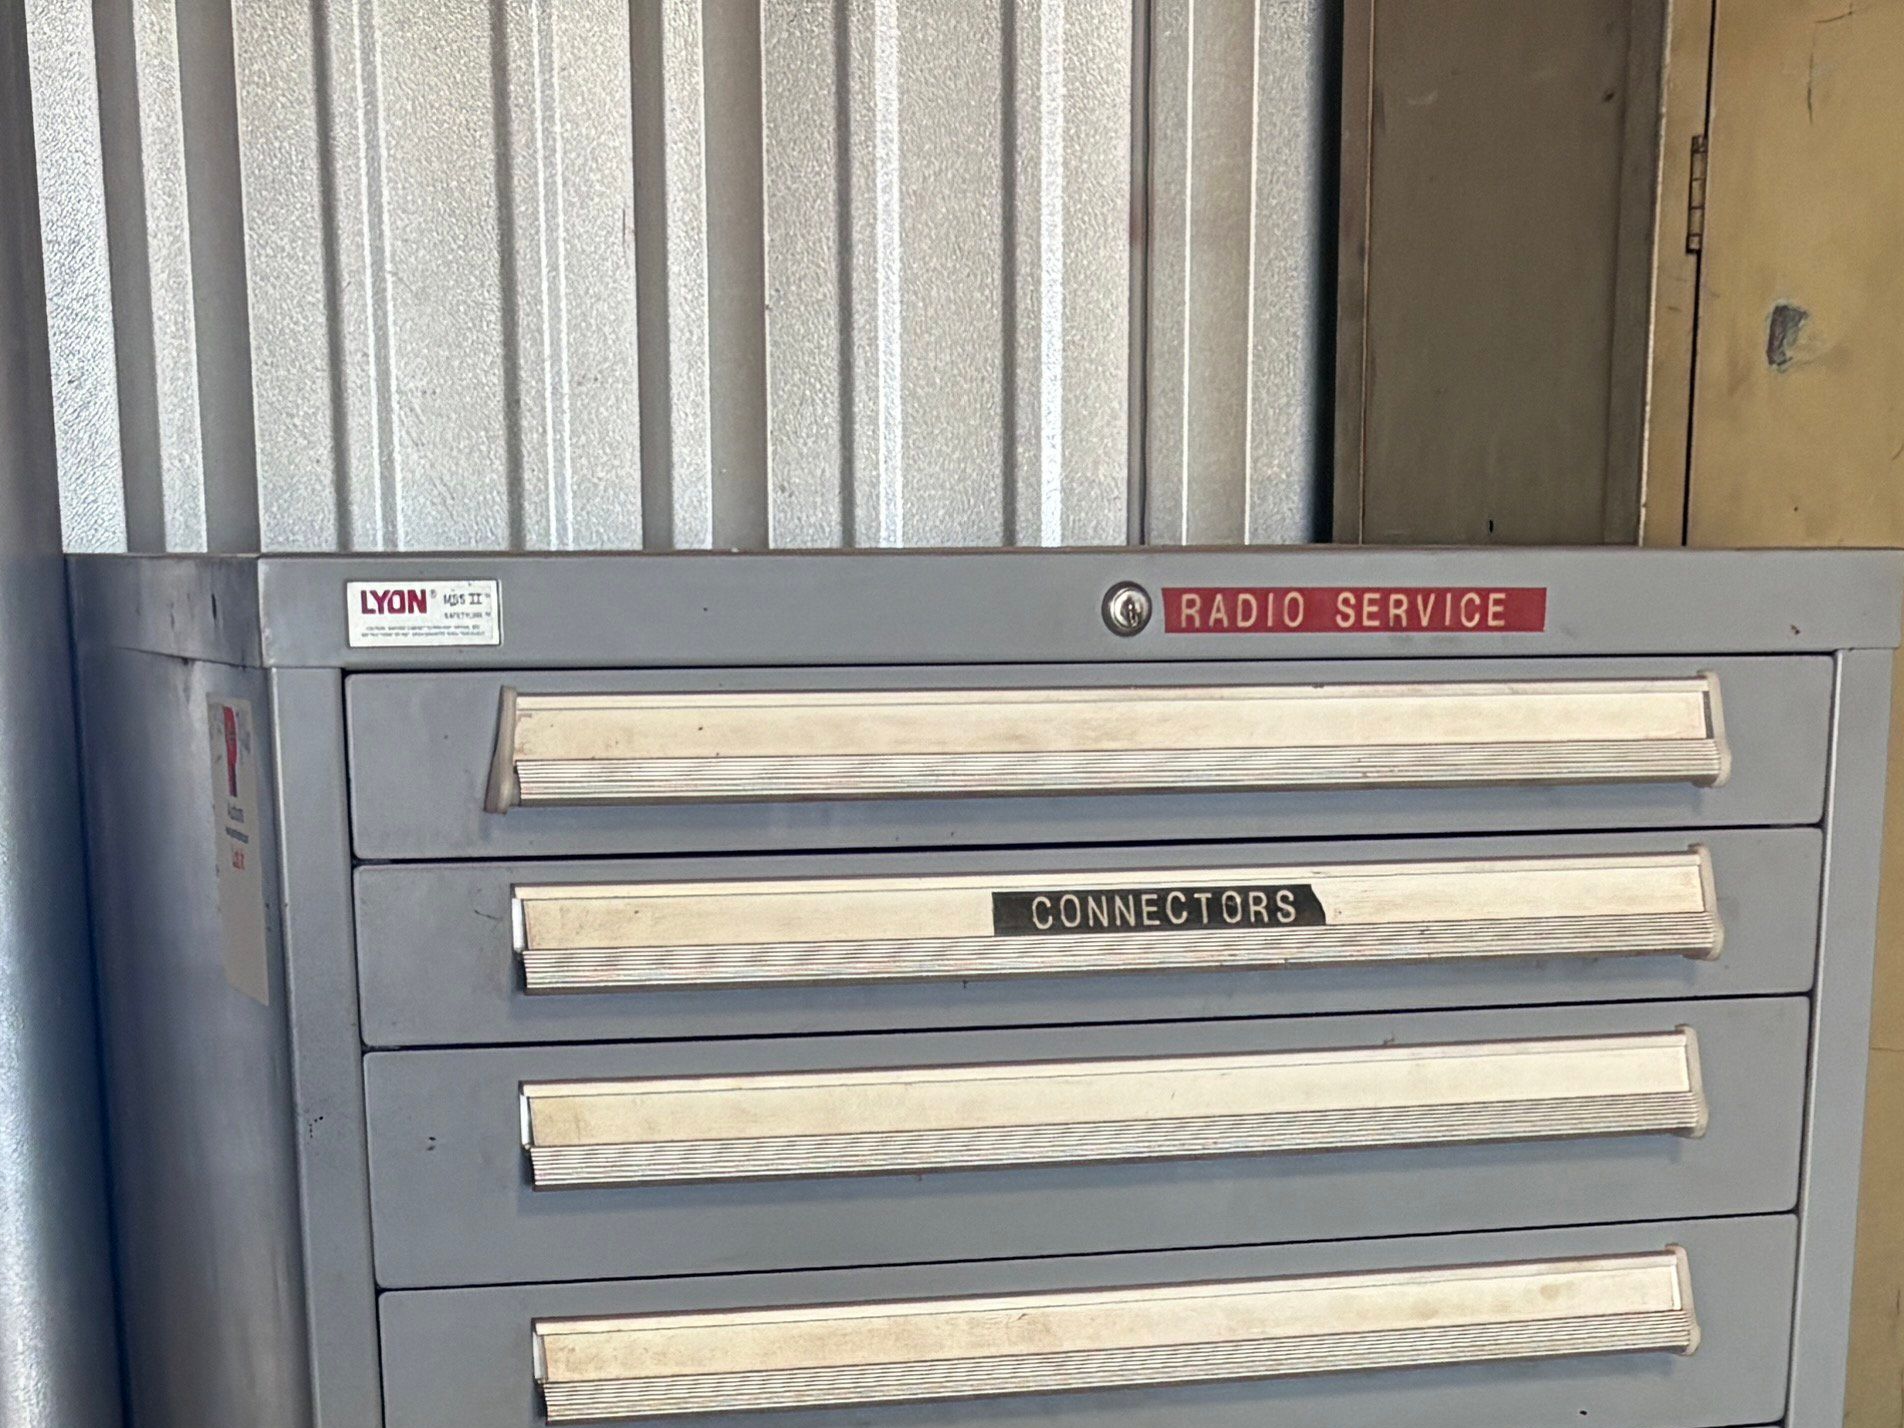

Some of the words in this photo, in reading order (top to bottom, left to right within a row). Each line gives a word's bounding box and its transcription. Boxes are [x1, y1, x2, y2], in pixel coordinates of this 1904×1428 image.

[360, 589, 428, 615] LYON
[1181, 591, 1304, 629] RADIO
[1335, 591, 1506, 629] SERVICE
[1031, 889, 1297, 930] CONNECTORS
